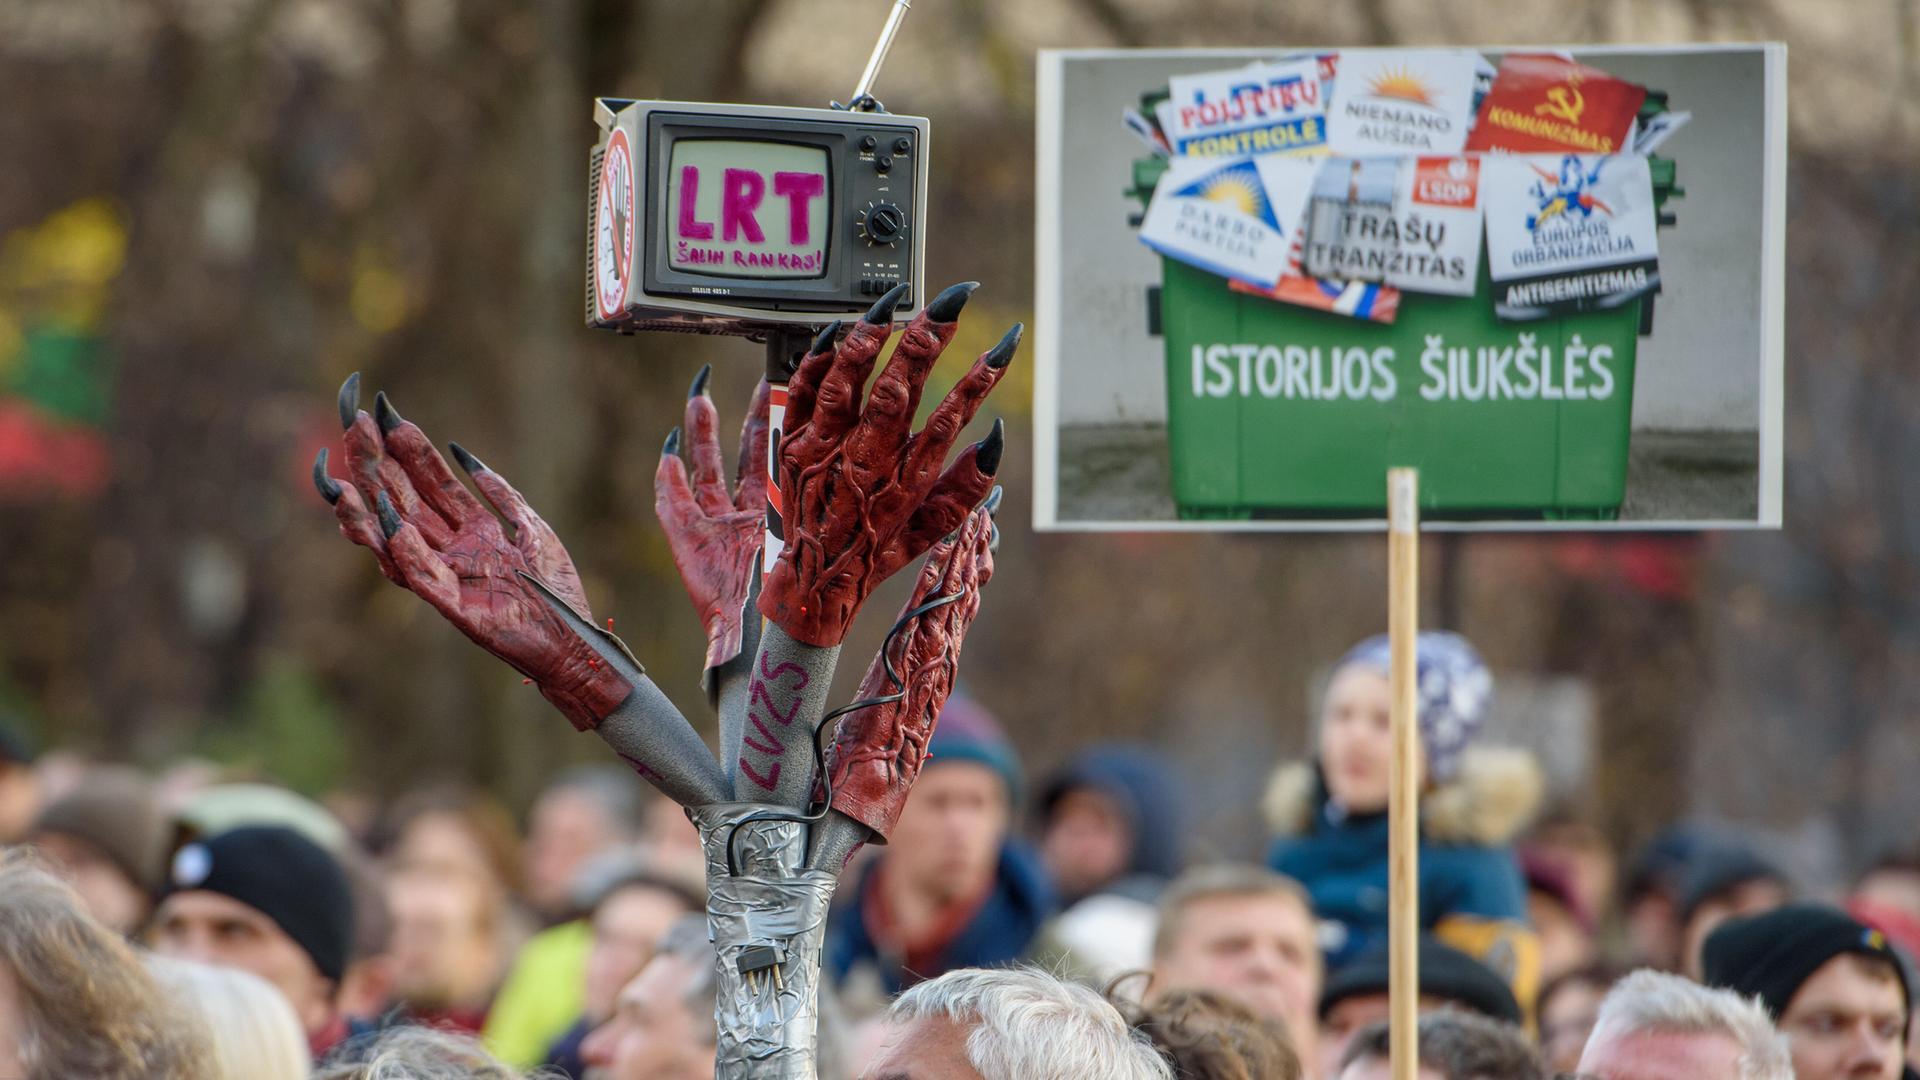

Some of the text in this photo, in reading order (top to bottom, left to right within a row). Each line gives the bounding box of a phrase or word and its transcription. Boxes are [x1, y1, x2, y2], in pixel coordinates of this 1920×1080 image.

[1346, 100, 1450, 132] NIEMANO
[1357, 120, 1432, 148] AUŠRA
[1489, 105, 1612, 153] KOMUNIZMAS
[678, 166, 824, 244] LRT
[1419, 179, 1472, 201] LSDP
[1174, 219, 1257, 259] PARTIJA
[1181, 203, 1264, 241] DARBO
[1341, 211, 1446, 251] TRĄŠŲ
[1532, 220, 1609, 246] EUROPOS
[1312, 244, 1466, 280] TRANZITAS
[1506, 266, 1648, 308] ANTISEMITIZMAS
[1191, 333, 1615, 400] ISTORIJOS ŠIUKŠLĖS
